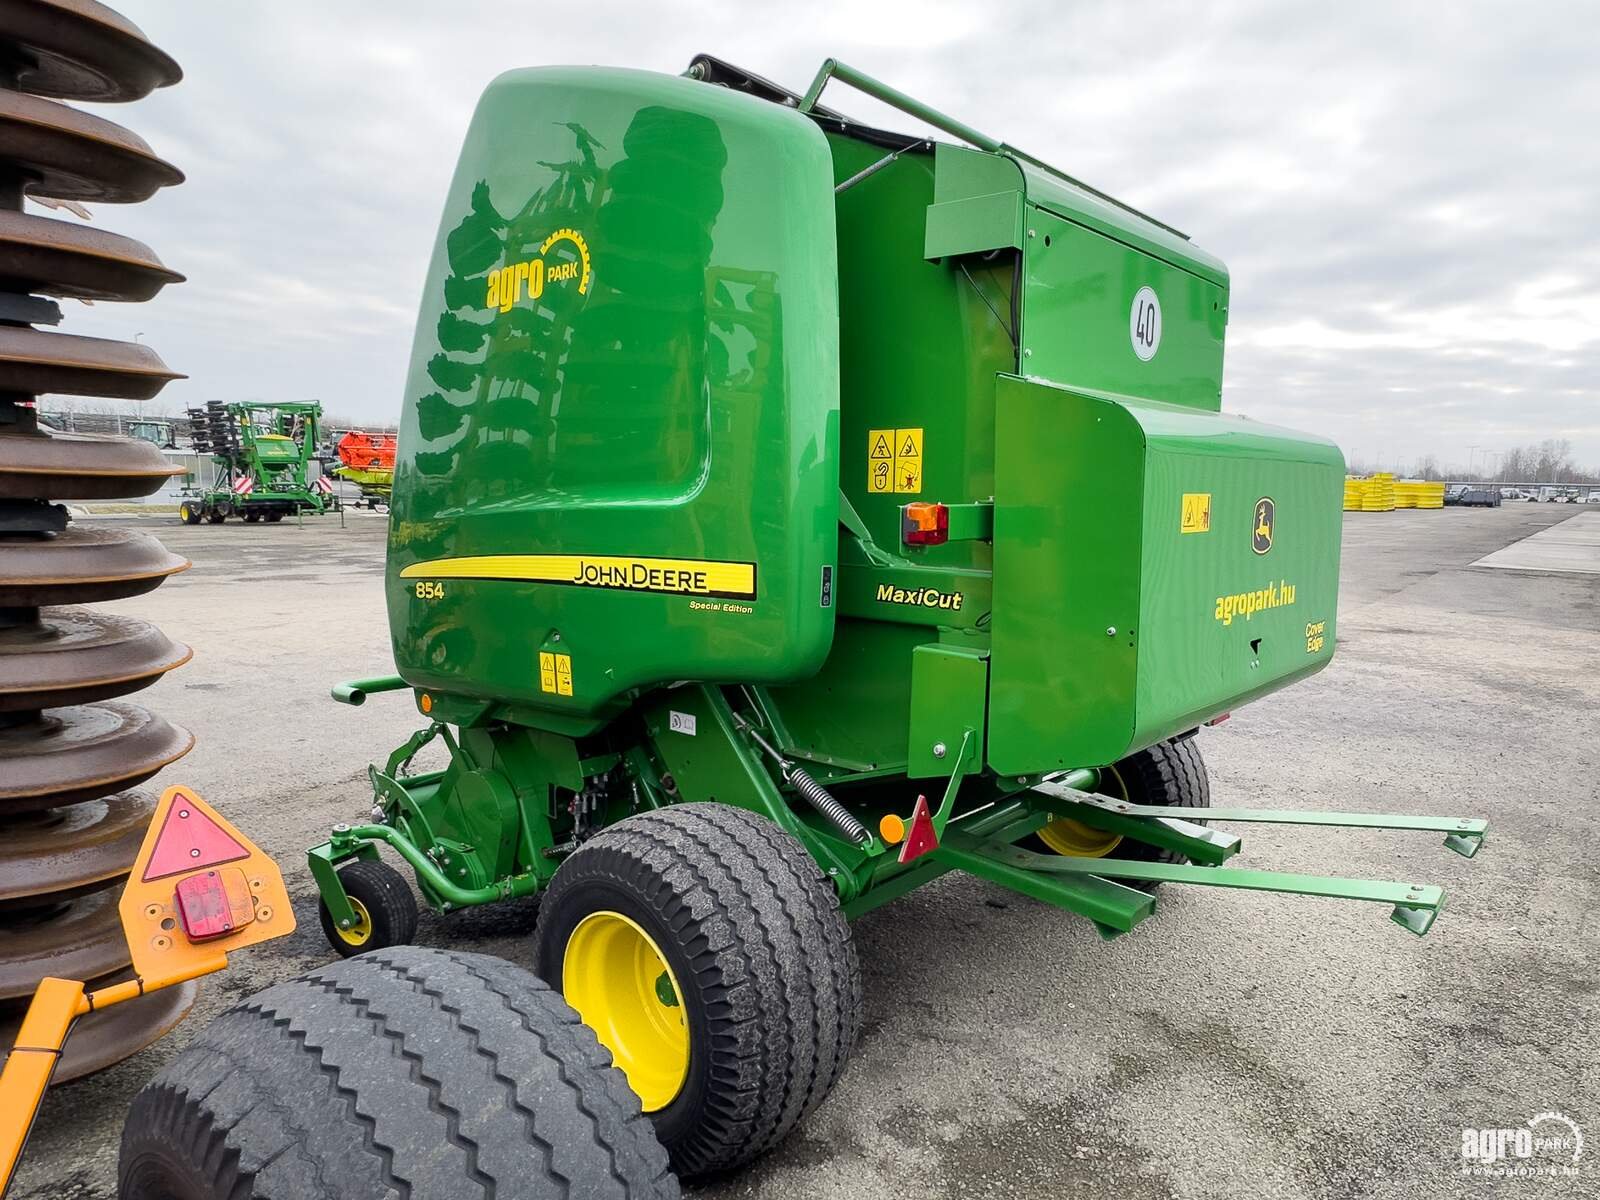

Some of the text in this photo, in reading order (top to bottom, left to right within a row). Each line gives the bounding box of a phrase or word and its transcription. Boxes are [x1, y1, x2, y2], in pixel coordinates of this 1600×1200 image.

[485, 258, 578, 313] agro PARK
[1136, 299, 1155, 348] 40
[415, 581, 445, 599] 854
[574, 561, 709, 592] JOHN DEERE
[689, 600, 753, 614] Special Edition
[876, 583, 963, 612] MaxiCut
[1214, 579, 1296, 626] agropark.hu
[1305, 620, 1326, 638] Cover
[1306, 635, 1324, 654] Edge
